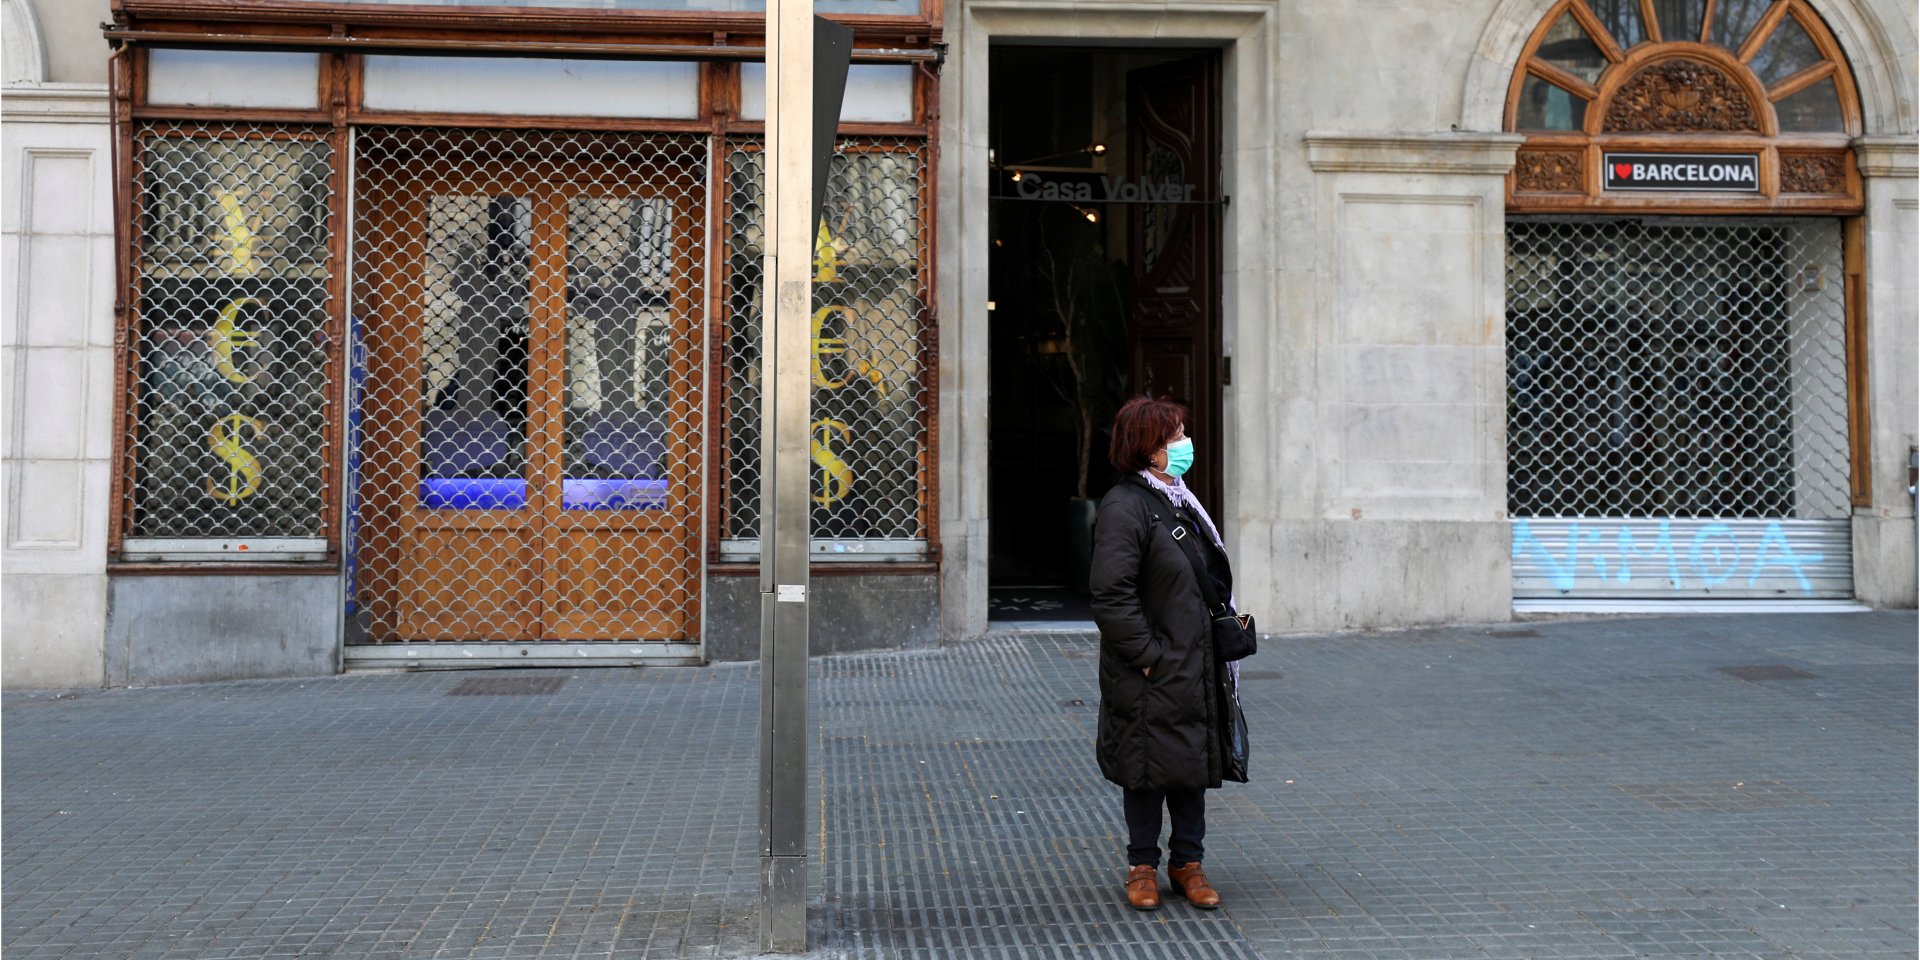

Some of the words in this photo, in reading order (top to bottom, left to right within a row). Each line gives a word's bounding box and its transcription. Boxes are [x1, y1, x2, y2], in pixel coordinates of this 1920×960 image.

[1633, 163, 1755, 182] BARCELONA
[1016, 172, 1092, 201] Casa
[1101, 175, 1196, 201] Volver
